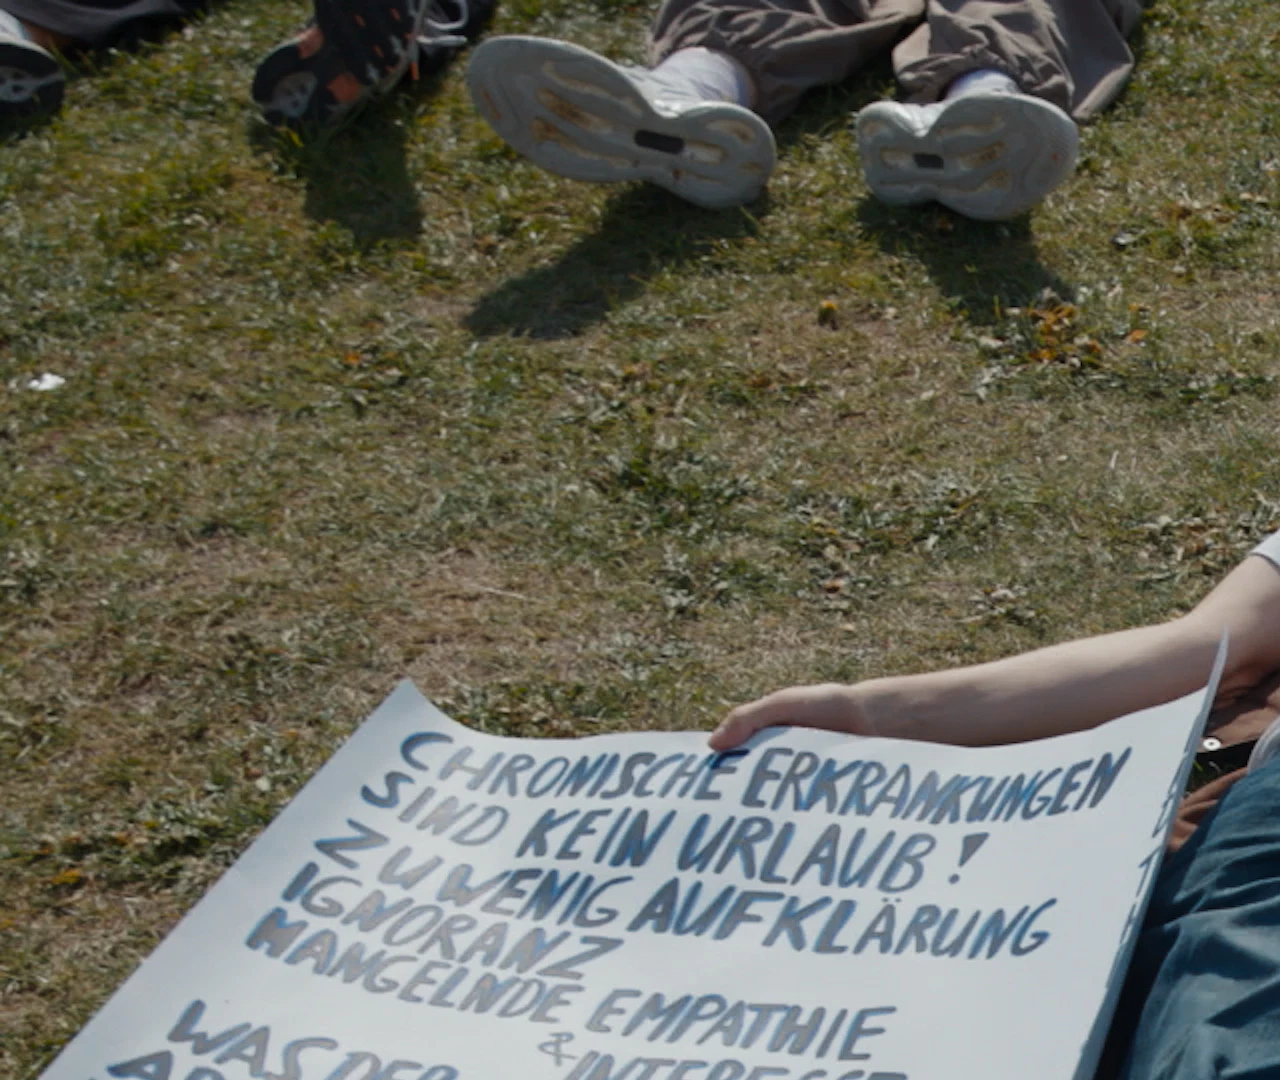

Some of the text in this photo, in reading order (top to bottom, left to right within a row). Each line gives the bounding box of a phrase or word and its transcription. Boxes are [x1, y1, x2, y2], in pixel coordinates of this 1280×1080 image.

[361, 772, 509, 846] SIND
[516, 807, 676, 867] KEIN
[402, 731, 1132, 825] CHRONISCHE ERKRANKUNGEN
[281, 862, 624, 981] IGNORANZ
[626, 876, 1057, 960] AUFKLÄRUNG
[244, 906, 898, 1061] MANGELNDE EMPATHIE
